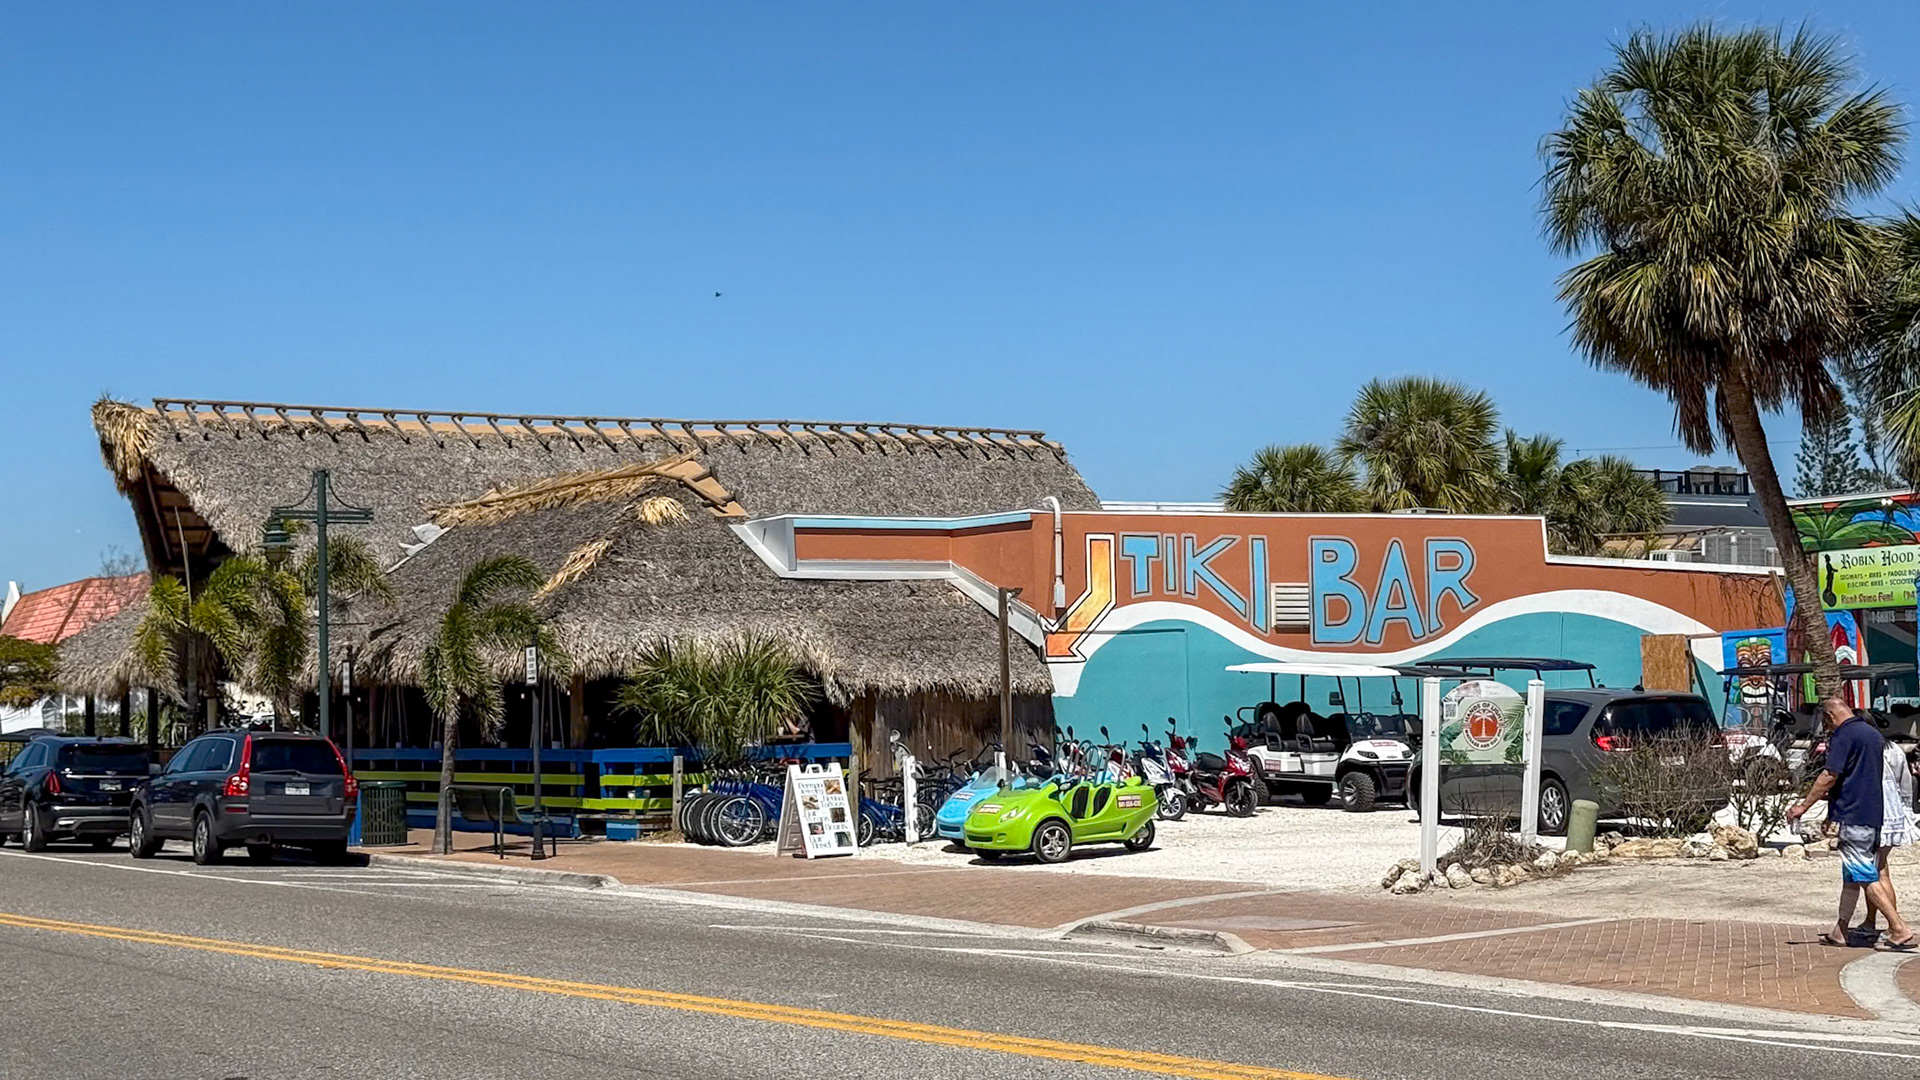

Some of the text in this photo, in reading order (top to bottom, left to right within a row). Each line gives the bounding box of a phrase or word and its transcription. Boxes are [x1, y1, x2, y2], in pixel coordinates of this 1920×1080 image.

[1840, 553, 1876, 569] ROBIN
[1881, 550, 1914, 566] HOOD
[1119, 532, 1481, 646] TIKI BAR
[1465, 703, 1481, 722] HANDS
[1491, 706, 1503, 722] LIGHT
